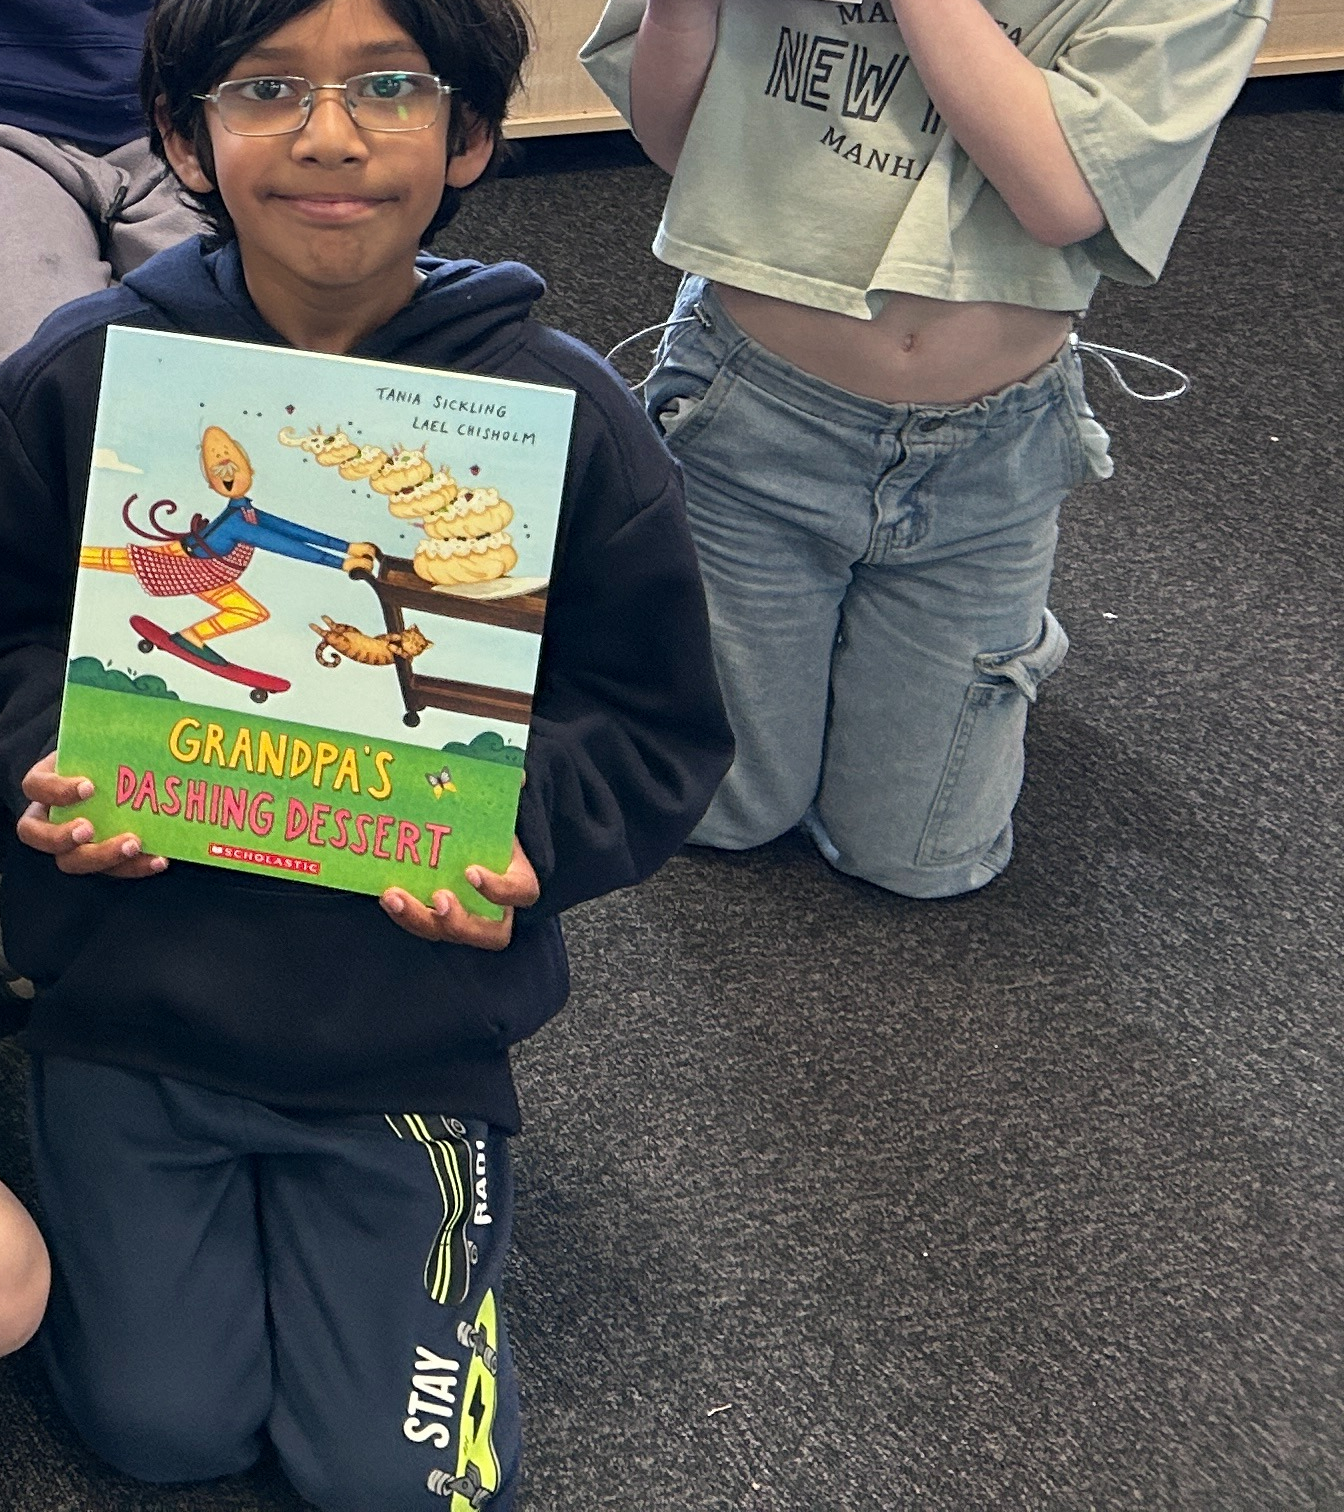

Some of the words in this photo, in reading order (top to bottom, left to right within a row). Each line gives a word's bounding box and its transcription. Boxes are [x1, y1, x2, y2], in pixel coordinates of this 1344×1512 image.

[764, 25, 910, 123] NEW
[376, 385, 425, 408] TANIA
[433, 394, 507, 419] SICKLING
[412, 416, 449, 436] LAEL
[457, 421, 537, 447] CHISHOLM
[169, 716, 393, 800] GRANDPA'S
[116, 764, 274, 838] DASHING
[284, 795, 453, 870] DESSERT
[224, 846, 318, 874] SCHOLASTIC
[403, 1345, 460, 1449] STAY
